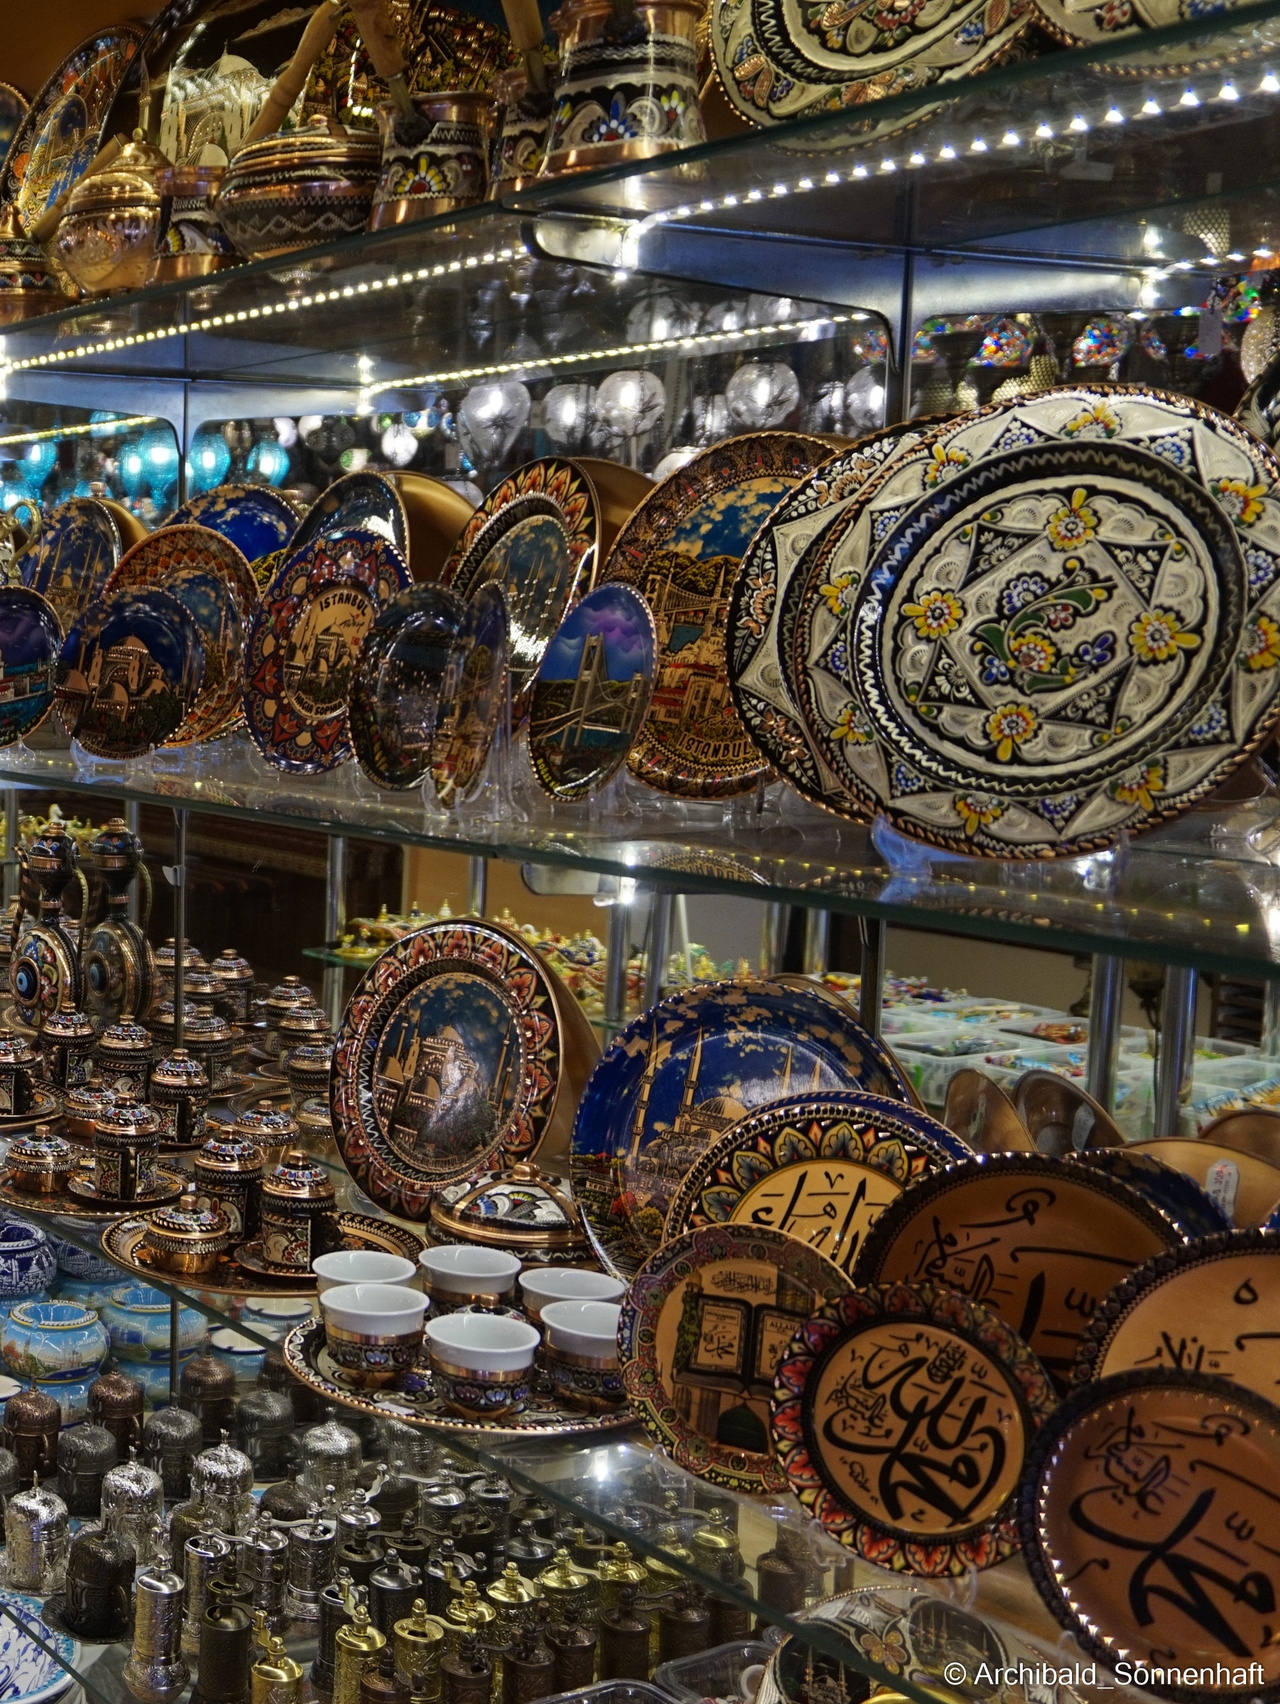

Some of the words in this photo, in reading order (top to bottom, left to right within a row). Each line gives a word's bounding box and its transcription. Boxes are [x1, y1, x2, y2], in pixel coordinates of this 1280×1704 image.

[319, 592, 368, 617] ISTANBUL
[293, 693, 313, 715] HAGIA
[678, 733, 753, 761] ISTANBUL
